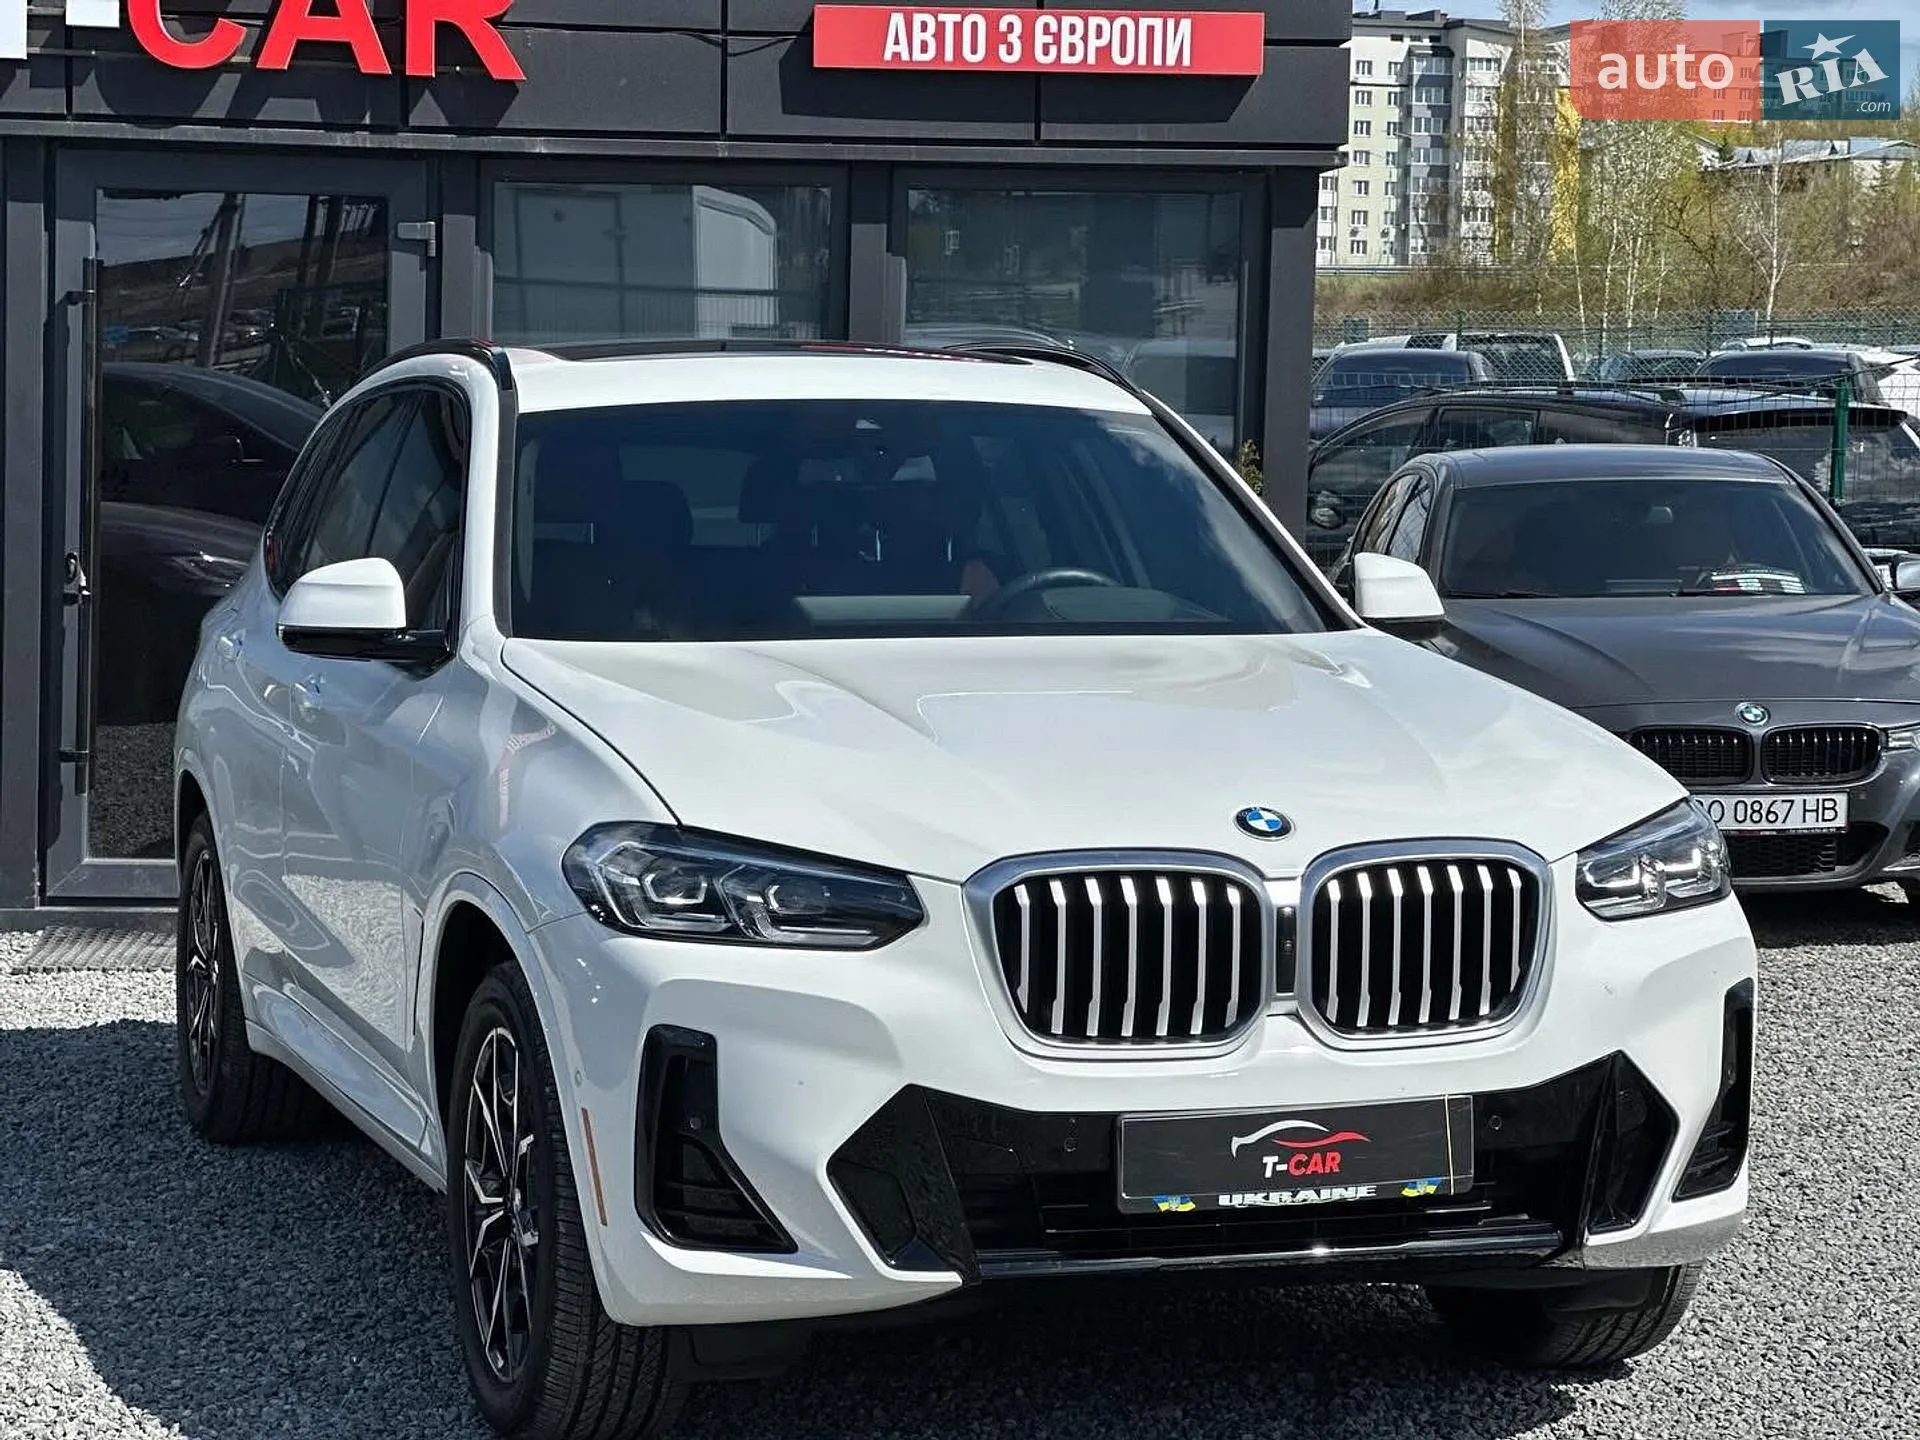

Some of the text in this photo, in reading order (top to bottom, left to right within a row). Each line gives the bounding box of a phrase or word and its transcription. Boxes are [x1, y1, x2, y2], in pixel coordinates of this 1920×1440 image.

[883, 12, 987, 63] АВТО
[1034, 14, 1192, 67] ЄВРОПИ
[1695, 798, 1839, 824] O 0867 HB
[1262, 1151, 1342, 1179] T-CAR
[1218, 1185, 1378, 1208] UKRAINE
